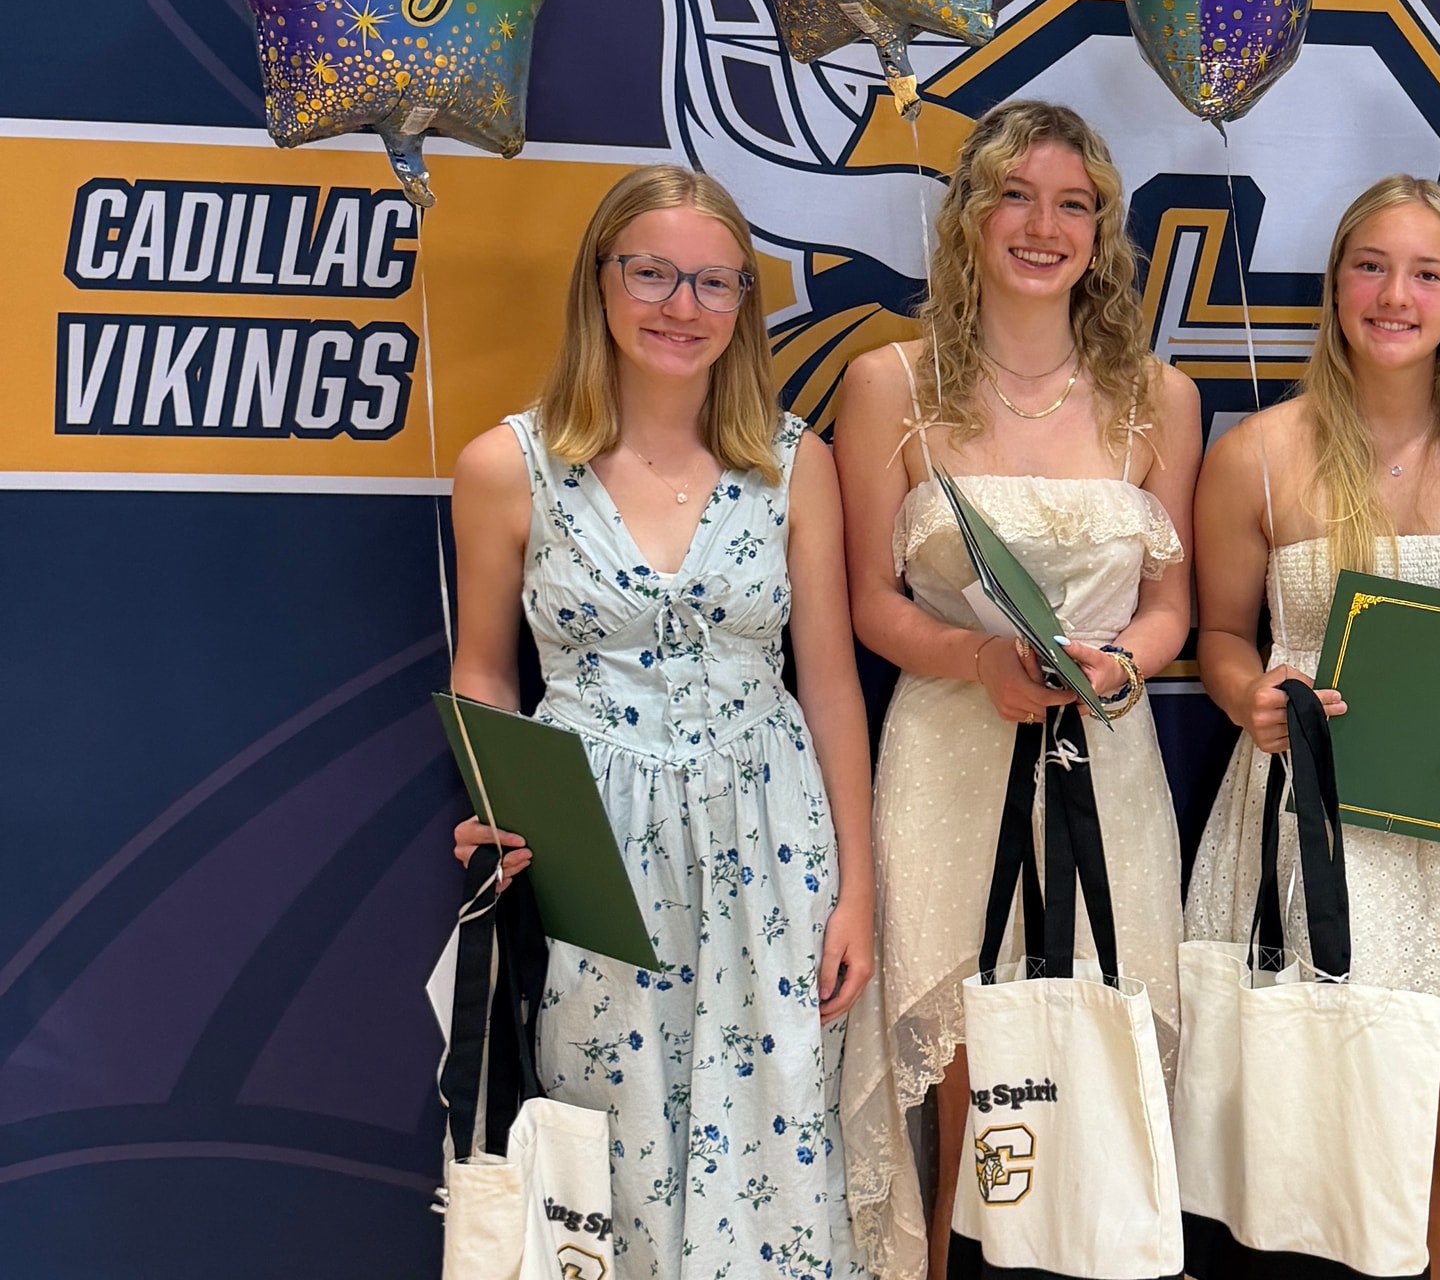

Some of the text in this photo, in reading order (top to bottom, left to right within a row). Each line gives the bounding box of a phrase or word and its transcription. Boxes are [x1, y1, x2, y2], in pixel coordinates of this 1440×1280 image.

[74, 187, 414, 289] CADILLAC
[66, 323, 408, 431] VIKINGS
[992, 1077, 1058, 1111] Spirit
